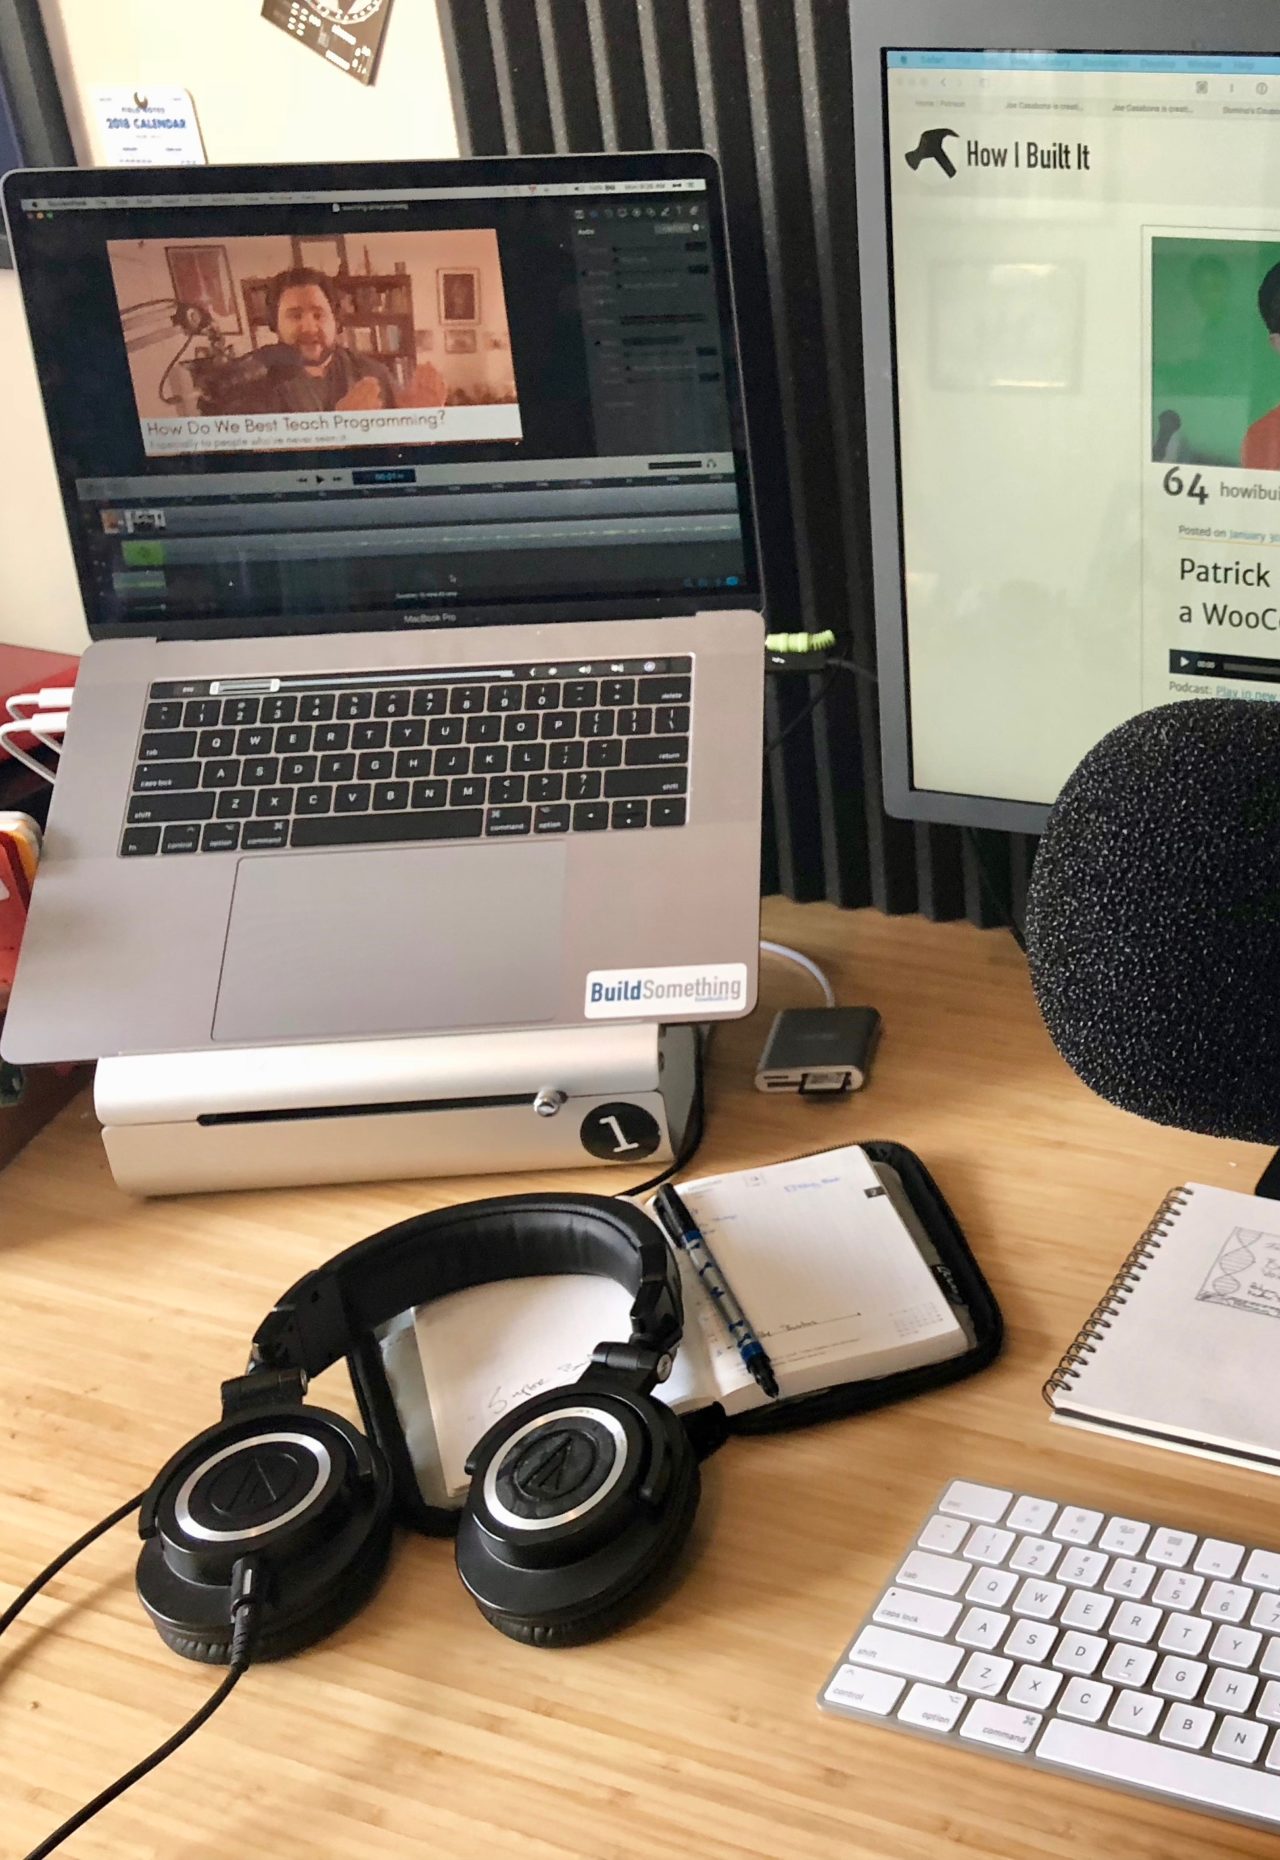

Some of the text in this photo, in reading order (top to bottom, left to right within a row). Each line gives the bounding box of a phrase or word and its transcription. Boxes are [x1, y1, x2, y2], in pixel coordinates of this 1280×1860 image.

[106, 118, 186, 129] 2018 CALENDAR
[967, 140, 1089, 170] How I Built It
[147, 410, 445, 436] How Do We Best Teach Programming?
[1164, 467, 1208, 505] 64
[1179, 525, 1211, 537] Posted
[1214, 528, 1227, 537] on
[1181, 558, 1270, 587] Patrick
[404, 612, 456, 624] MacBook Pro
[1179, 606, 1191, 623] a
[1169, 681, 1212, 695] Podcast:
[1216, 686, 1238, 701] Play
[1241, 689, 1252, 698] in
[1256, 690, 1277, 701] new
[599, 1115, 639, 1152] 1
[881, 1610, 918, 1623] caps lock
[987, 1582, 998, 1591] Q
[1034, 1593, 1048, 1602] W
[1083, 1604, 1093, 1614] E
[1131, 1616, 1141, 1626] R
[1183, 1628, 1192, 1638] T
[1233, 1640, 1242, 1650] Y
[857, 1649, 877, 1658] shift
[983, 1728, 1026, 1743] command
